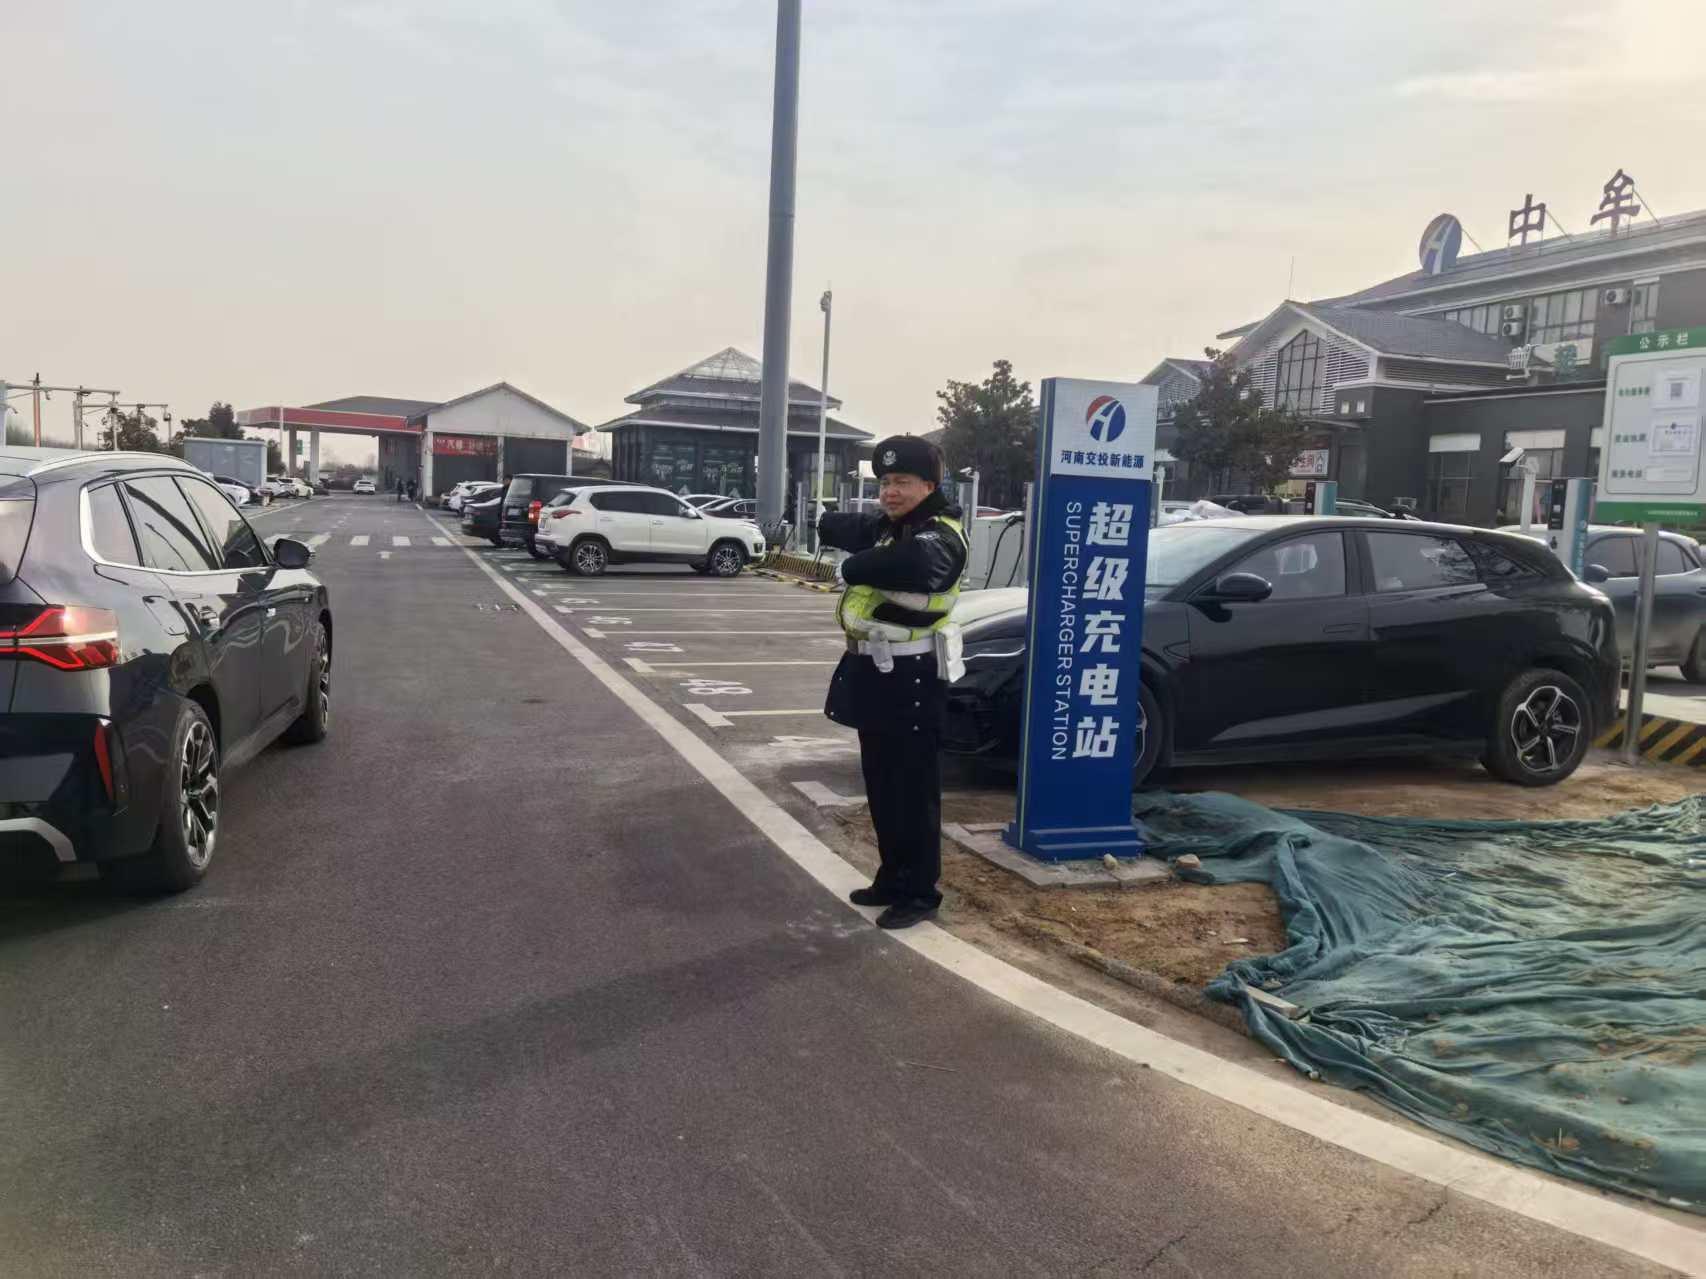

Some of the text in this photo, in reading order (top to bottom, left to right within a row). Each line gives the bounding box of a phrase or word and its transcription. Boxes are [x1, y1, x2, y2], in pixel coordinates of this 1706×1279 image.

[1508, 168, 1641, 247] 中牟
[1639, 332, 1689, 349] 公示栏
[1060, 449, 1145, 469] 河南交投新能源
[1072, 501, 1134, 758] 超级充电站
[679, 678, 752, 695] 48
